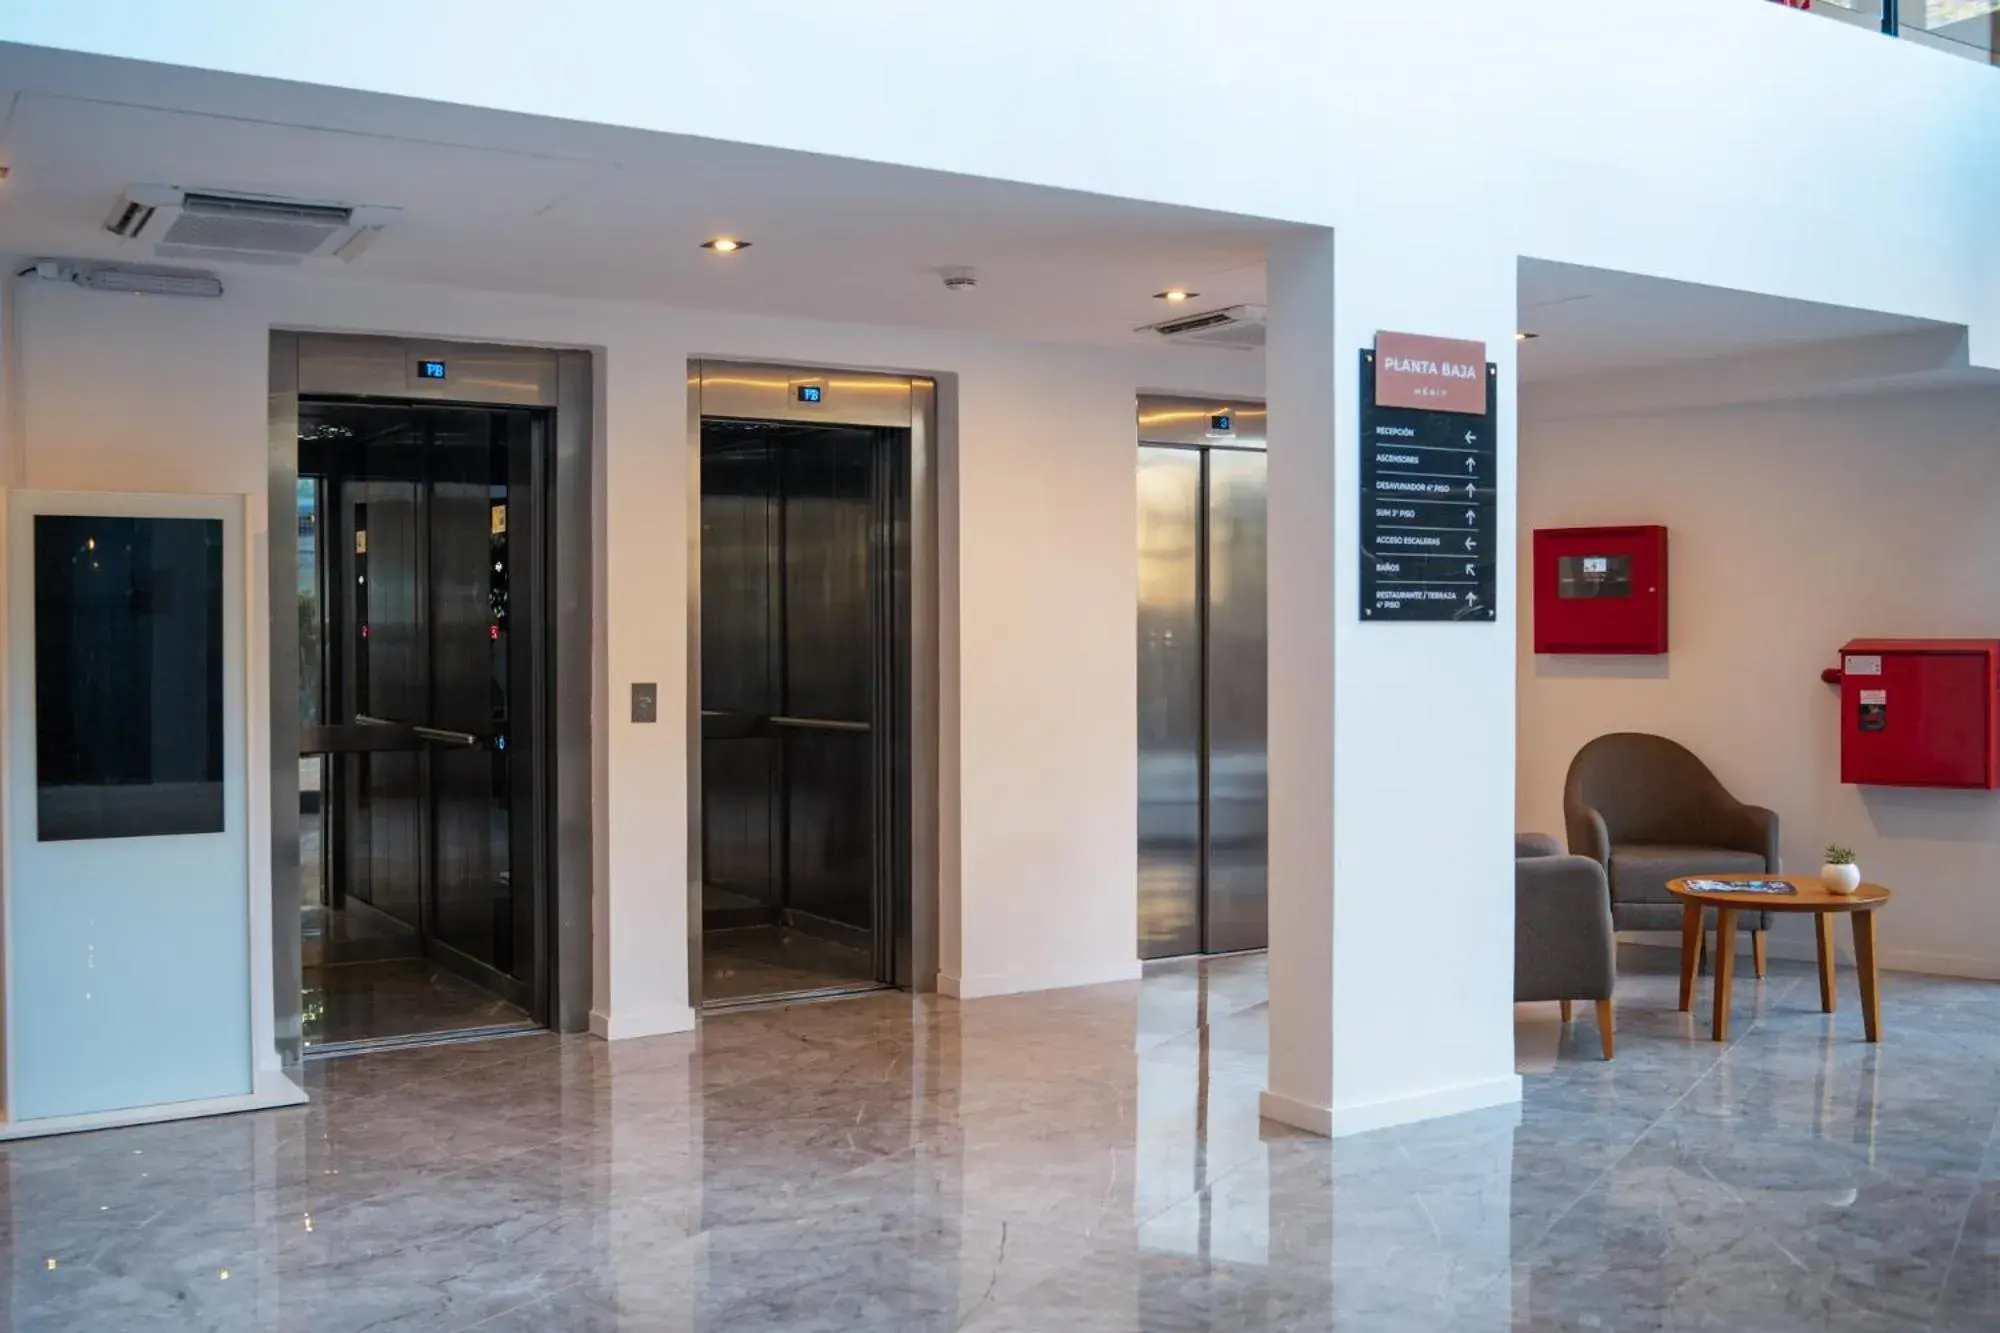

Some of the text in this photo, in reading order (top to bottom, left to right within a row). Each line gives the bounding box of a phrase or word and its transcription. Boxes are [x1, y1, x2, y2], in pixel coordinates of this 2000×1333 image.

[427, 363, 443, 377] PB
[1384, 356, 1477, 380] PLANTA BAJA
[804, 388, 818, 401] PB
[1376, 426, 1415, 437] RECEPCIÓN
[1376, 454, 1419, 464] ASCENSORES
[1434, 484, 1450, 493] PISO
[1376, 508, 1391, 517] SUM
[1399, 509, 1416, 518] PISO
[1376, 535, 1440, 546] ACCESO ESCALERAS
[1376, 562, 1400, 572] BAÑOS
[1376, 591, 1422, 600] RESTAURANTE
[1427, 591, 1457, 600] TERRAZA
[1384, 601, 1400, 609] PISO
